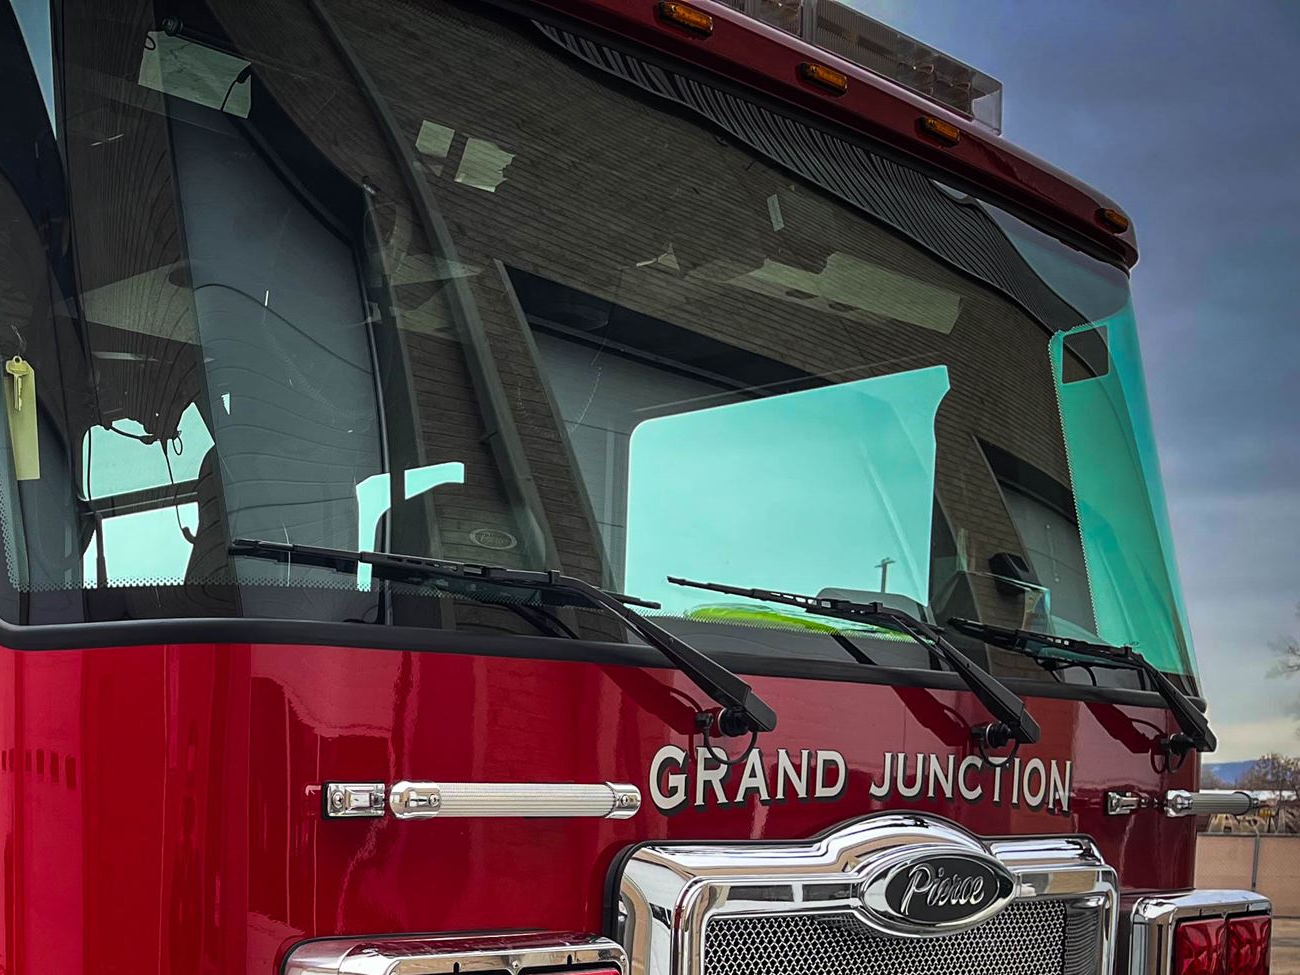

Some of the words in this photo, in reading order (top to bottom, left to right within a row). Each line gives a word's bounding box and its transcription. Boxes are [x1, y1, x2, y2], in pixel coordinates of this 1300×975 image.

[649, 744, 847, 812] GRAND
[869, 750, 1074, 813] JUNCTION
[900, 863, 985, 916] Pierce
